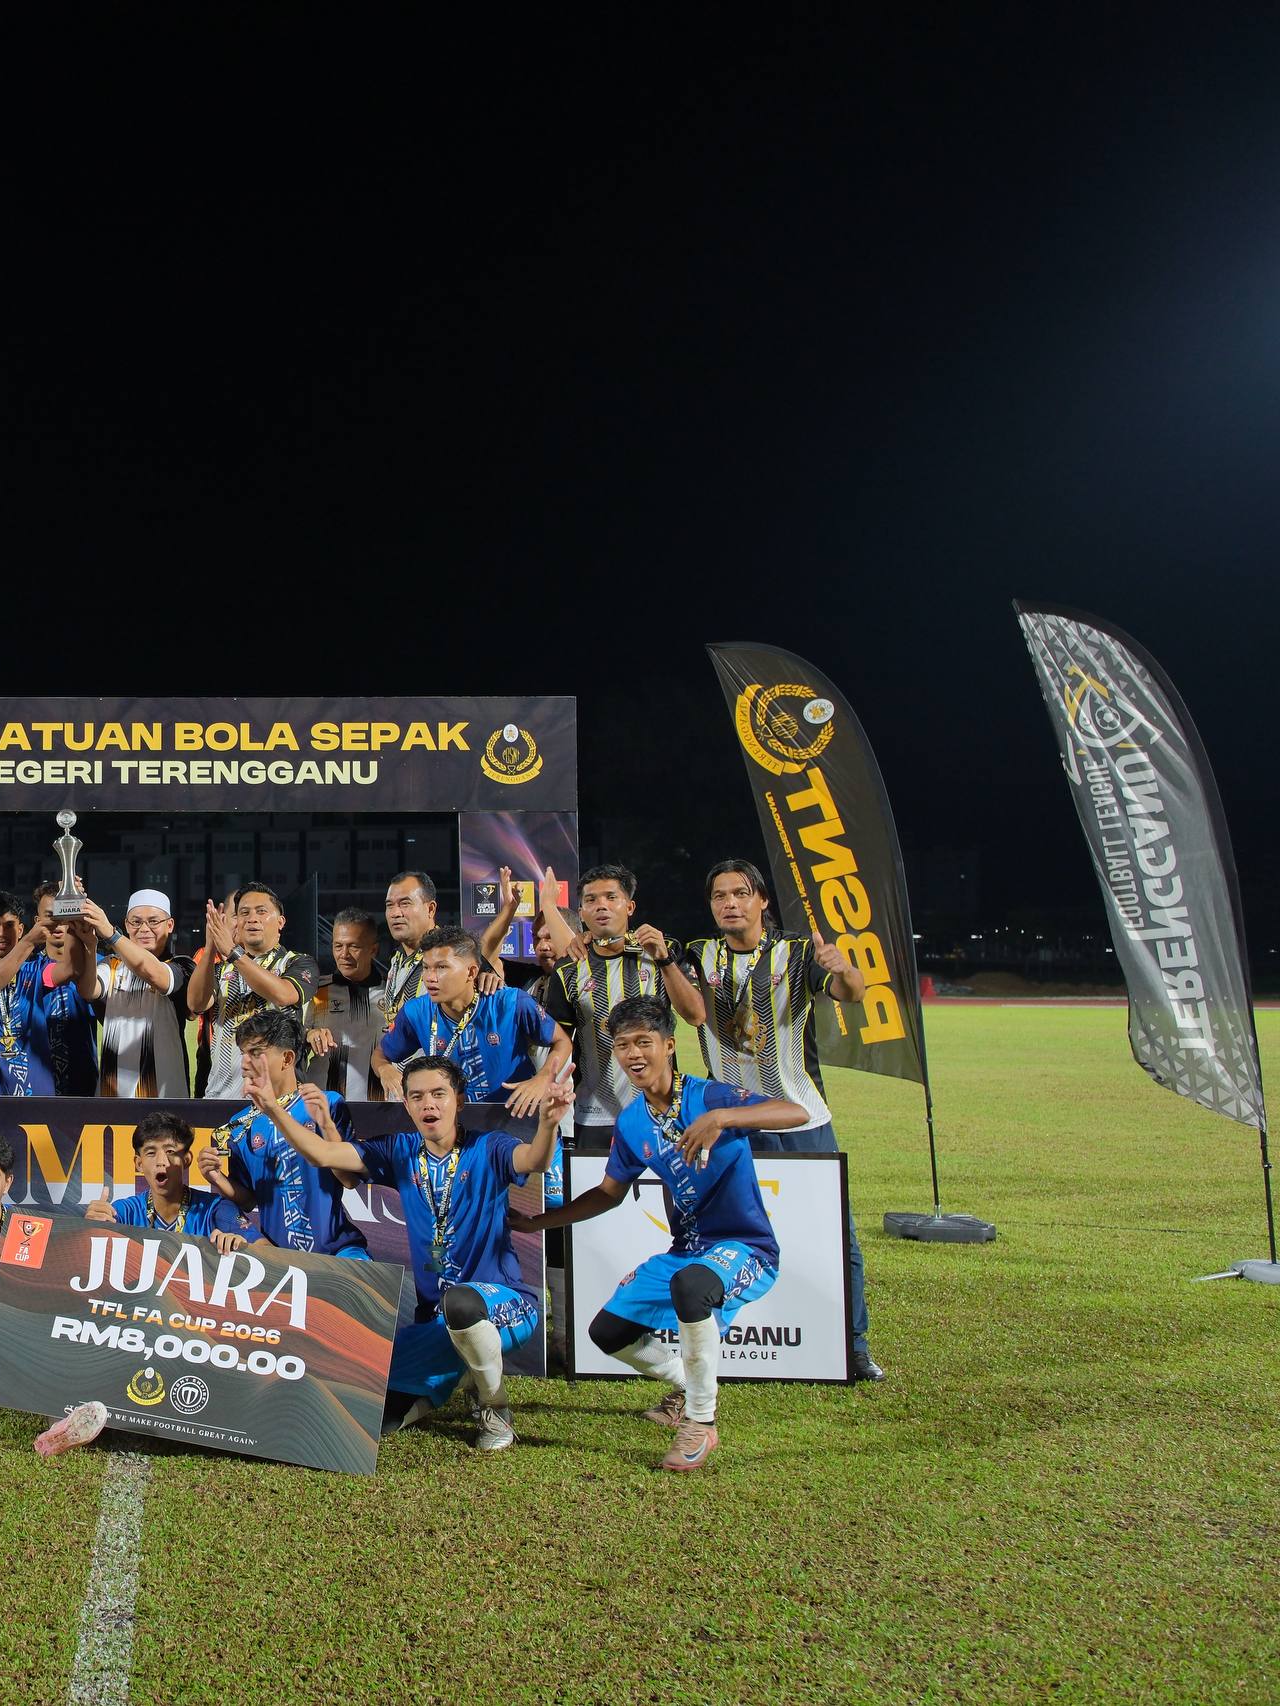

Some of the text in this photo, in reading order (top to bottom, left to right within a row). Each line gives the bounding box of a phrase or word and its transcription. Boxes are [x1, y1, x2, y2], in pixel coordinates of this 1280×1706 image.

[174, 722, 293, 751] BOLA
[310, 722, 470, 751] SEPAK
[111, 760, 379, 785] TERENGGANU
[14, 1253, 30, 1262] CUP
[19, 1246, 29, 1254] FA
[70, 1236, 308, 1330] JUARA
[88, 1298, 281, 1345] TFL FA CUP 2026
[50, 1316, 306, 1381] RM8,000.00
[722, 1350, 777, 1360] LEAGUE
[114, 1413, 127, 1422] WE
[128, 1417, 152, 1426] MAKE
[153, 1421, 196, 1435] FOOTBALL
[198, 1429, 226, 1440] GREAT
